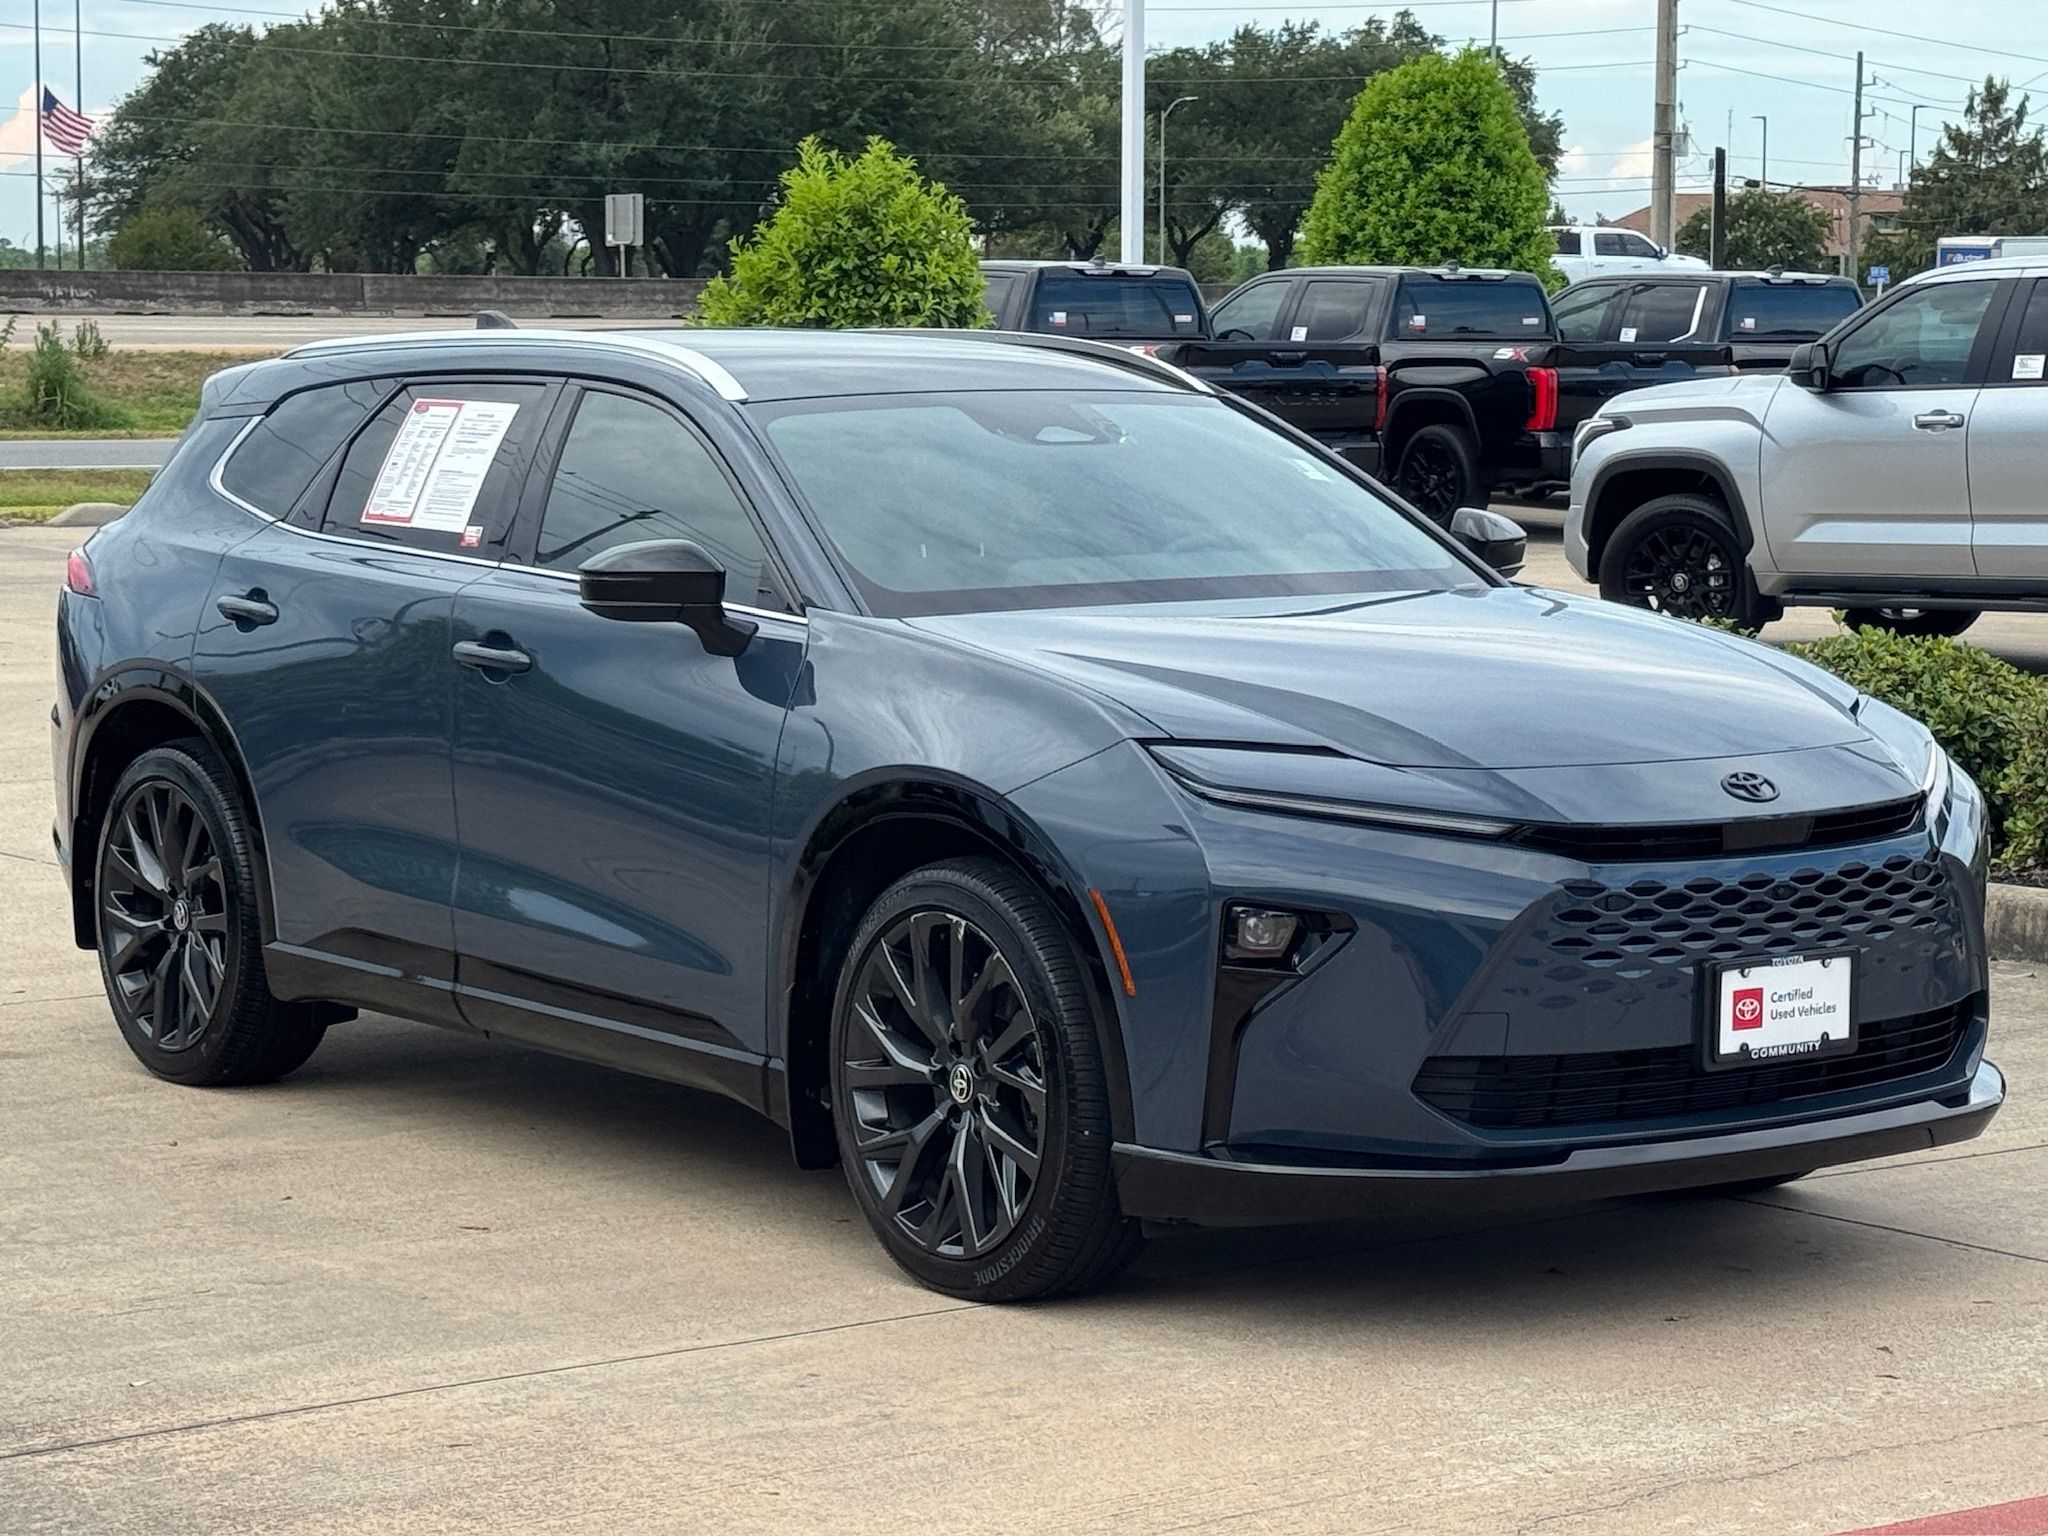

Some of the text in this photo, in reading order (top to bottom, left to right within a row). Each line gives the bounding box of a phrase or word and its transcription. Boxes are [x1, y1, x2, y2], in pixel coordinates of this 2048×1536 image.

[1771, 954, 1804, 967] TOYOTA
[1770, 987, 1813, 1003] Certified
[1771, 1001, 1837, 1021] Used Vehicles
[1751, 1040, 1822, 1060] COMMUNITY
[973, 1214, 1046, 1287] BRIDGESTONE
